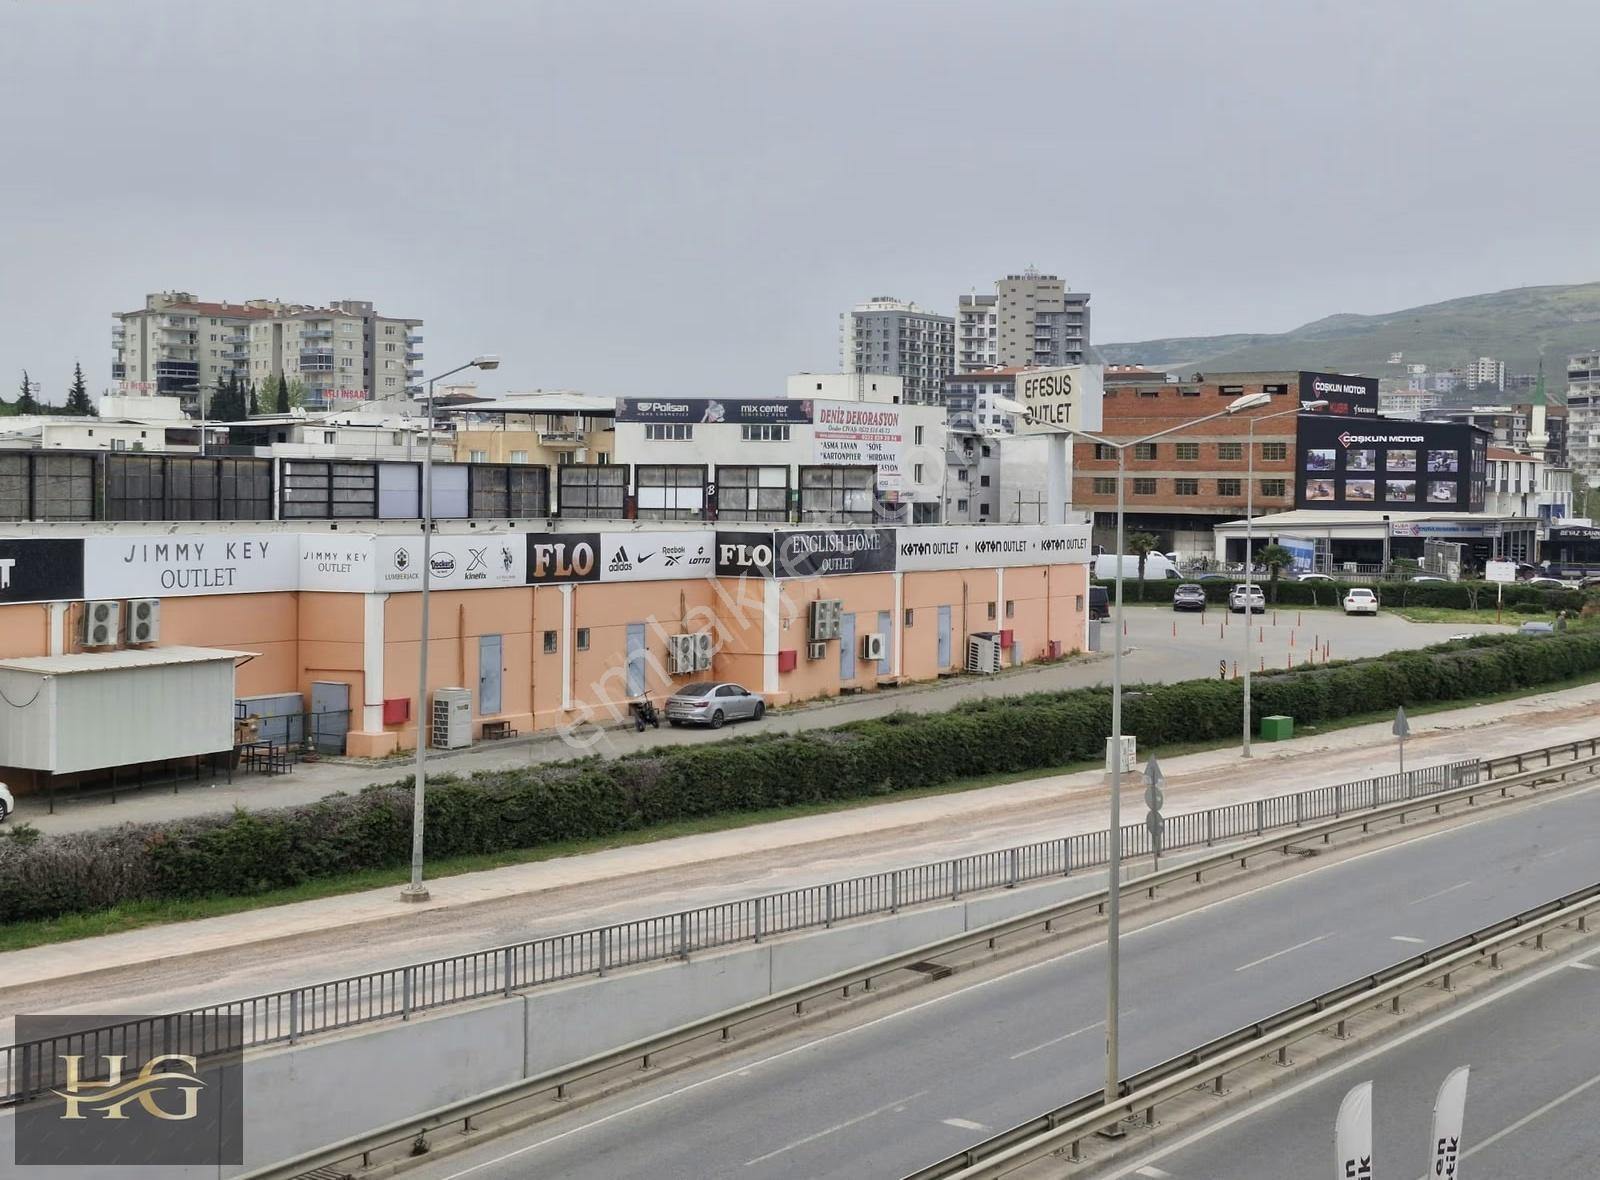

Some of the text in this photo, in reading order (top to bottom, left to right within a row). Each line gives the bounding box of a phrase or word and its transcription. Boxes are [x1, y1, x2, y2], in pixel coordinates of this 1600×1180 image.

[1025, 374, 1071, 398] EFESUS
[1315, 382, 1366, 395] COŞKUN MOTOR
[653, 402, 789, 413] Polisan mix center
[1025, 403, 1072, 425] OUTLET
[820, 407, 899, 426] DENİZ DEKORASYON
[823, 442, 839, 450] ASMA
[841, 442, 858, 450] TAVAN
[1343, 435, 1388, 444] COŞKUN
[868, 453, 896, 461] HIRDAVAT
[792, 533, 881, 554] ENGLISH HOME
[901, 537, 1088, 557] KOTON OUTLET KOTON OUTLET KOTON OUTLET
[124, 541, 270, 563] JIMMY KEY
[303, 551, 368, 562] JIMMY KEY
[662, 546, 685, 555] Reebok
[720, 543, 772, 567] FLO
[533, 542, 594, 577] FLO
[689, 557, 711, 565] LOTTO
[822, 557, 854, 571] OUTLET
[317, 563, 352, 573] OUTLET
[608, 562, 633, 572] adidas
[160, 567, 236, 589] OUTLET
